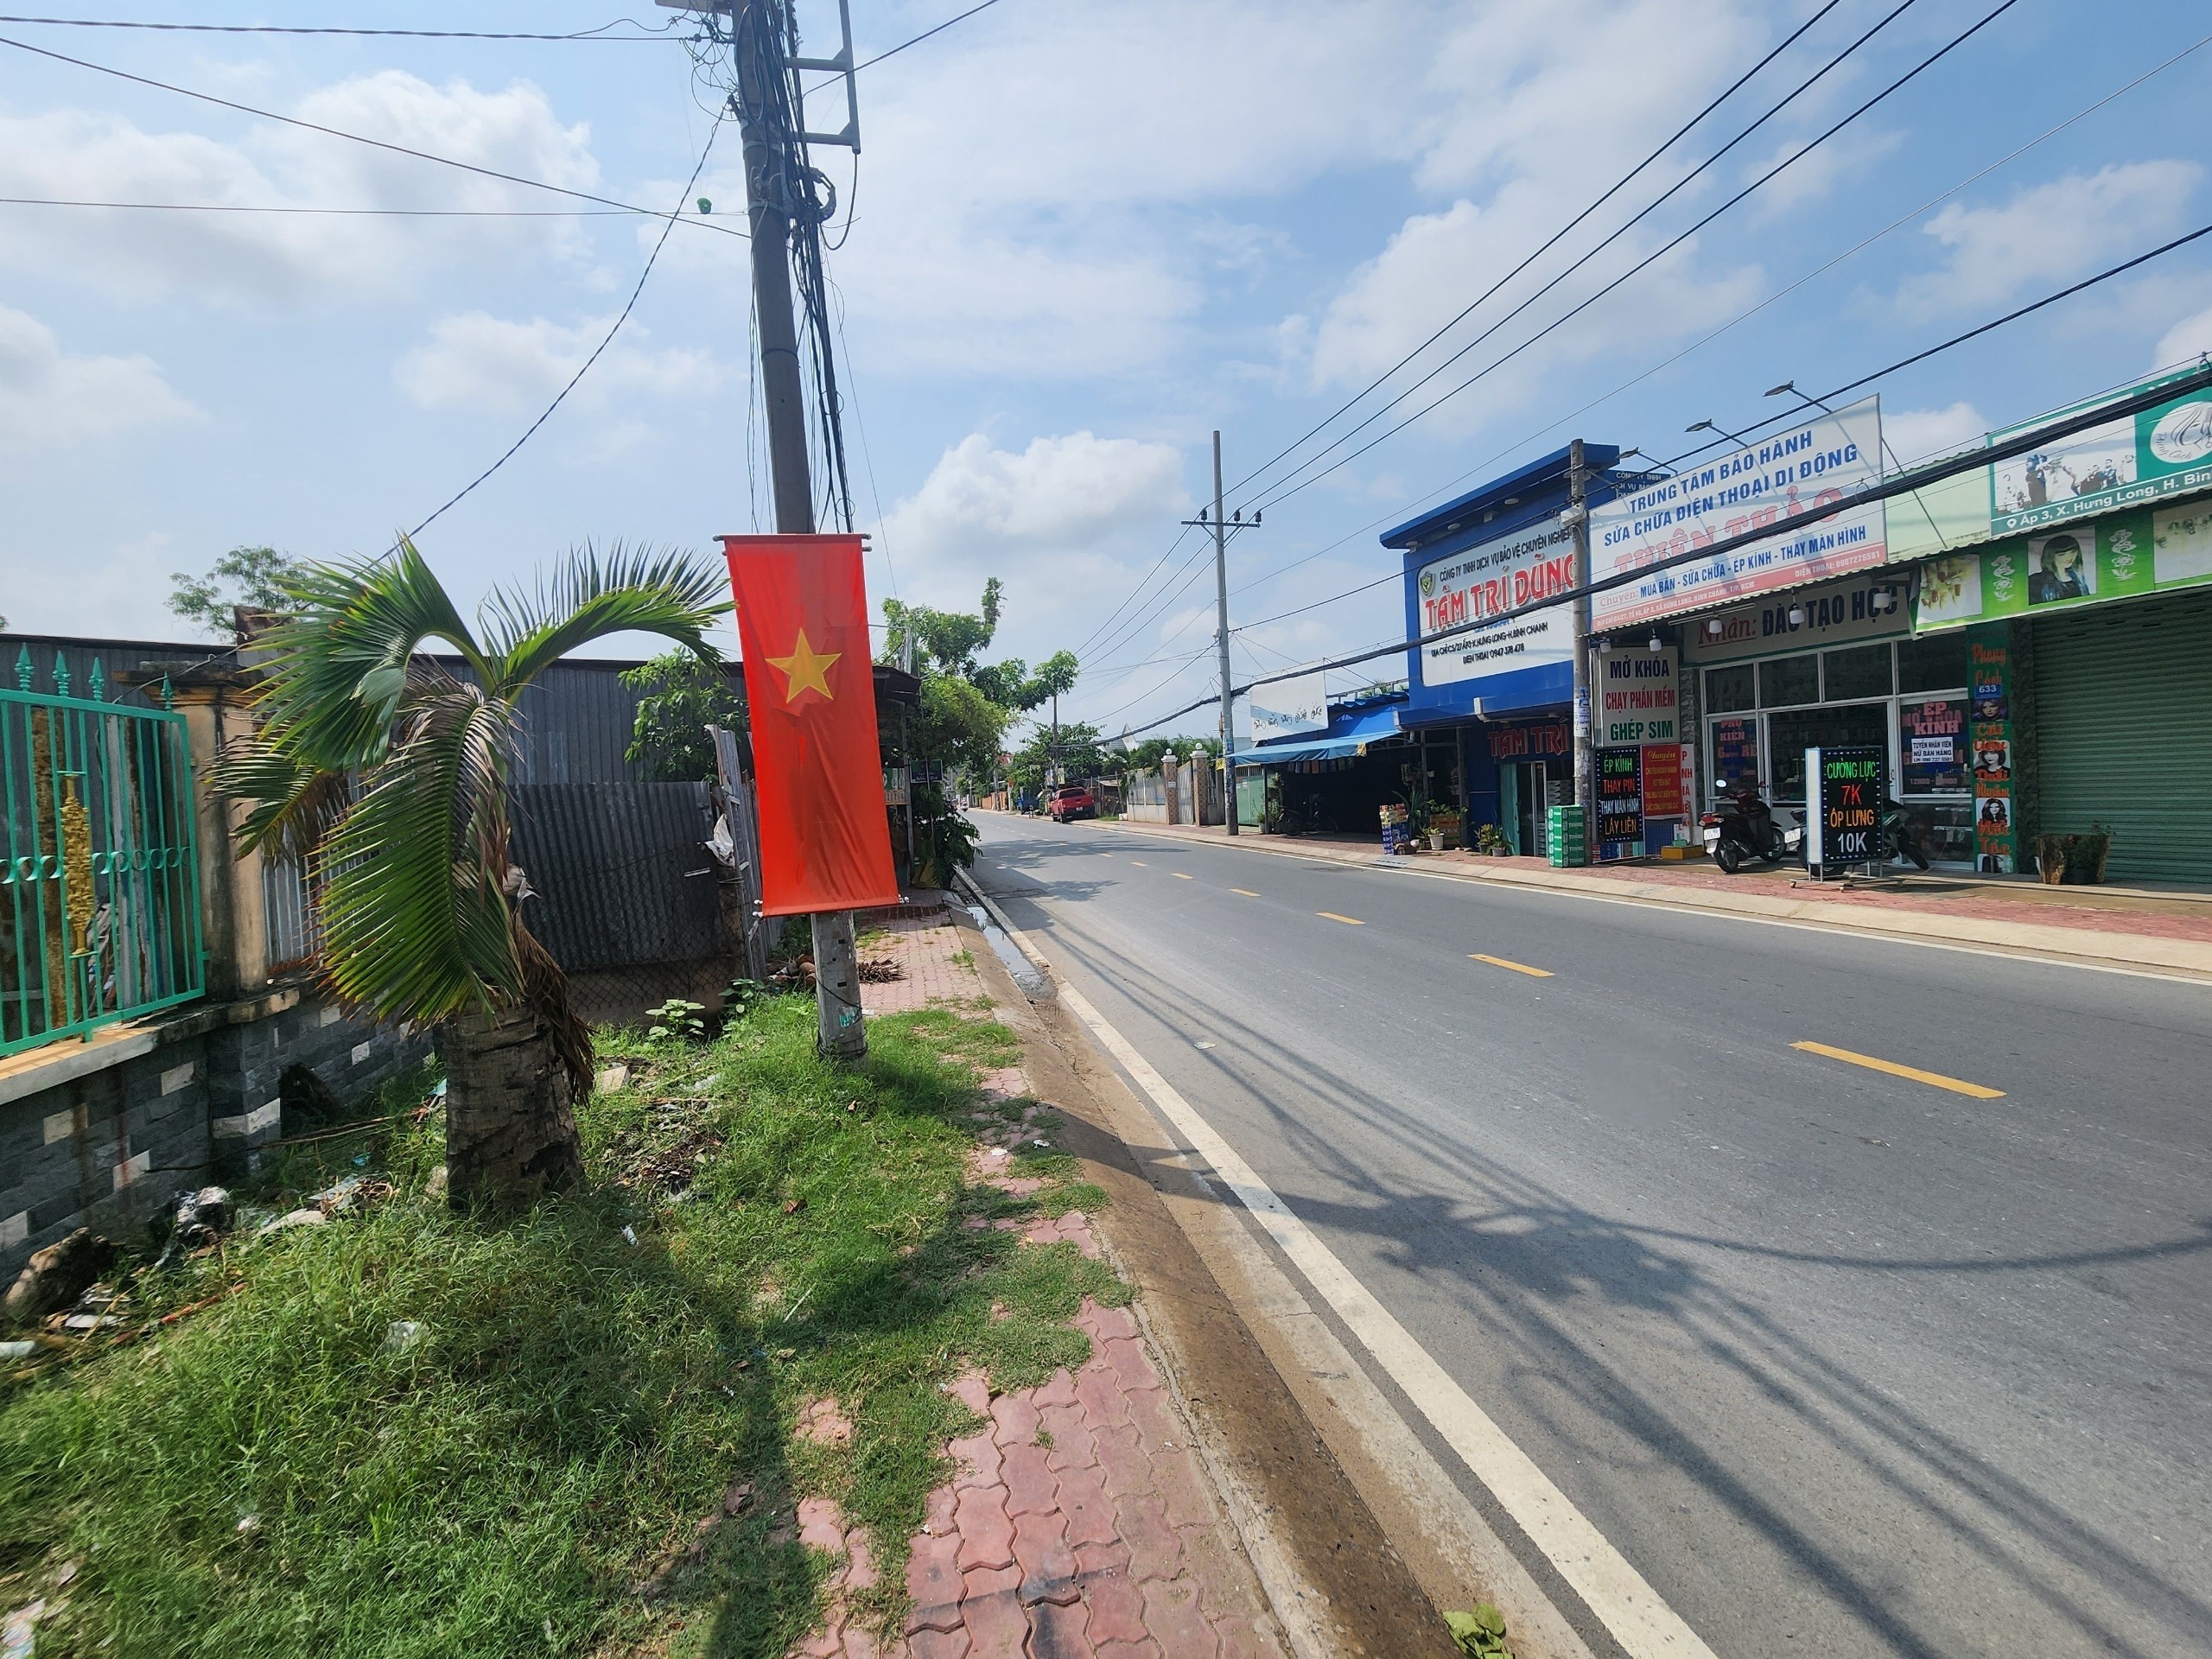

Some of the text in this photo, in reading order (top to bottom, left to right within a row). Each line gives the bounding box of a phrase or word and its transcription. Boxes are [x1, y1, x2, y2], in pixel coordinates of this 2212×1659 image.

[1630, 430, 1812, 514] TRUNG TÂM BẢO HÀNH
[1604, 443, 1858, 547] SỬA CHỮA ĐIỆN THOẠI DI ĐỘNG
[2056, 505, 2069, 517] X.
[2074, 496, 2113, 512] Hưng
[2117, 485, 2159, 502] Long,
[2164, 479, 2179, 490] H.
[1440, 567, 1455, 582] CÔNG
[1455, 564, 1463, 577] TY
[1477, 556, 1489, 571] DỊCH
[1491, 554, 1499, 569] VỤ
[1500, 544, 1511, 563] BẢO
[1512, 543, 1521, 558] VỆ
[1521, 534, 1547, 555] CHUYÊN
[1641, 583, 1656, 598] MUA
[1658, 576, 1675, 594] BÁN
[1682, 569, 1700, 587] SỬA
[1701, 563, 1726, 582] CHỮA
[1733, 553, 1745, 573] ÉP
[1748, 550, 1771, 569] KÍNH
[1781, 541, 1806, 560] THAY
[1809, 533, 1834, 554] MÀN
[1838, 525, 1866, 545] HÌNH
[1795, 568, 1811, 578] ĐIỆN
[1425, 584, 1467, 631] TÂM
[1471, 565, 1512, 618] TRÍ
[1806, 594, 1845, 632] TẠO
[1852, 587, 1897, 623] HỌC
[1610, 655, 1669, 678] MỞ KHÓA
[1979, 684, 1997, 693] 633
[1605, 692, 1627, 714] CHẠY
[1923, 699, 1947, 715] ÉP
[1488, 716, 1569, 759] TÂM TRÍ
[1610, 719, 1674, 741] GHÉP SIM
[1604, 754, 1613, 773] ÉP
[1615, 754, 1633, 772] KÍNH
[1827, 757, 1877, 782] CƯỜNG LỰC
[1603, 779, 1635, 794] THAY PIN
[1840, 784, 1862, 805] 7K
[1600, 800, 1614, 815] THAY
[1614, 796, 1626, 814] MÀN
[1627, 795, 1639, 812] HÌNH
[1846, 809, 1874, 827] LƯNG
[1838, 832, 1867, 853] 10K
